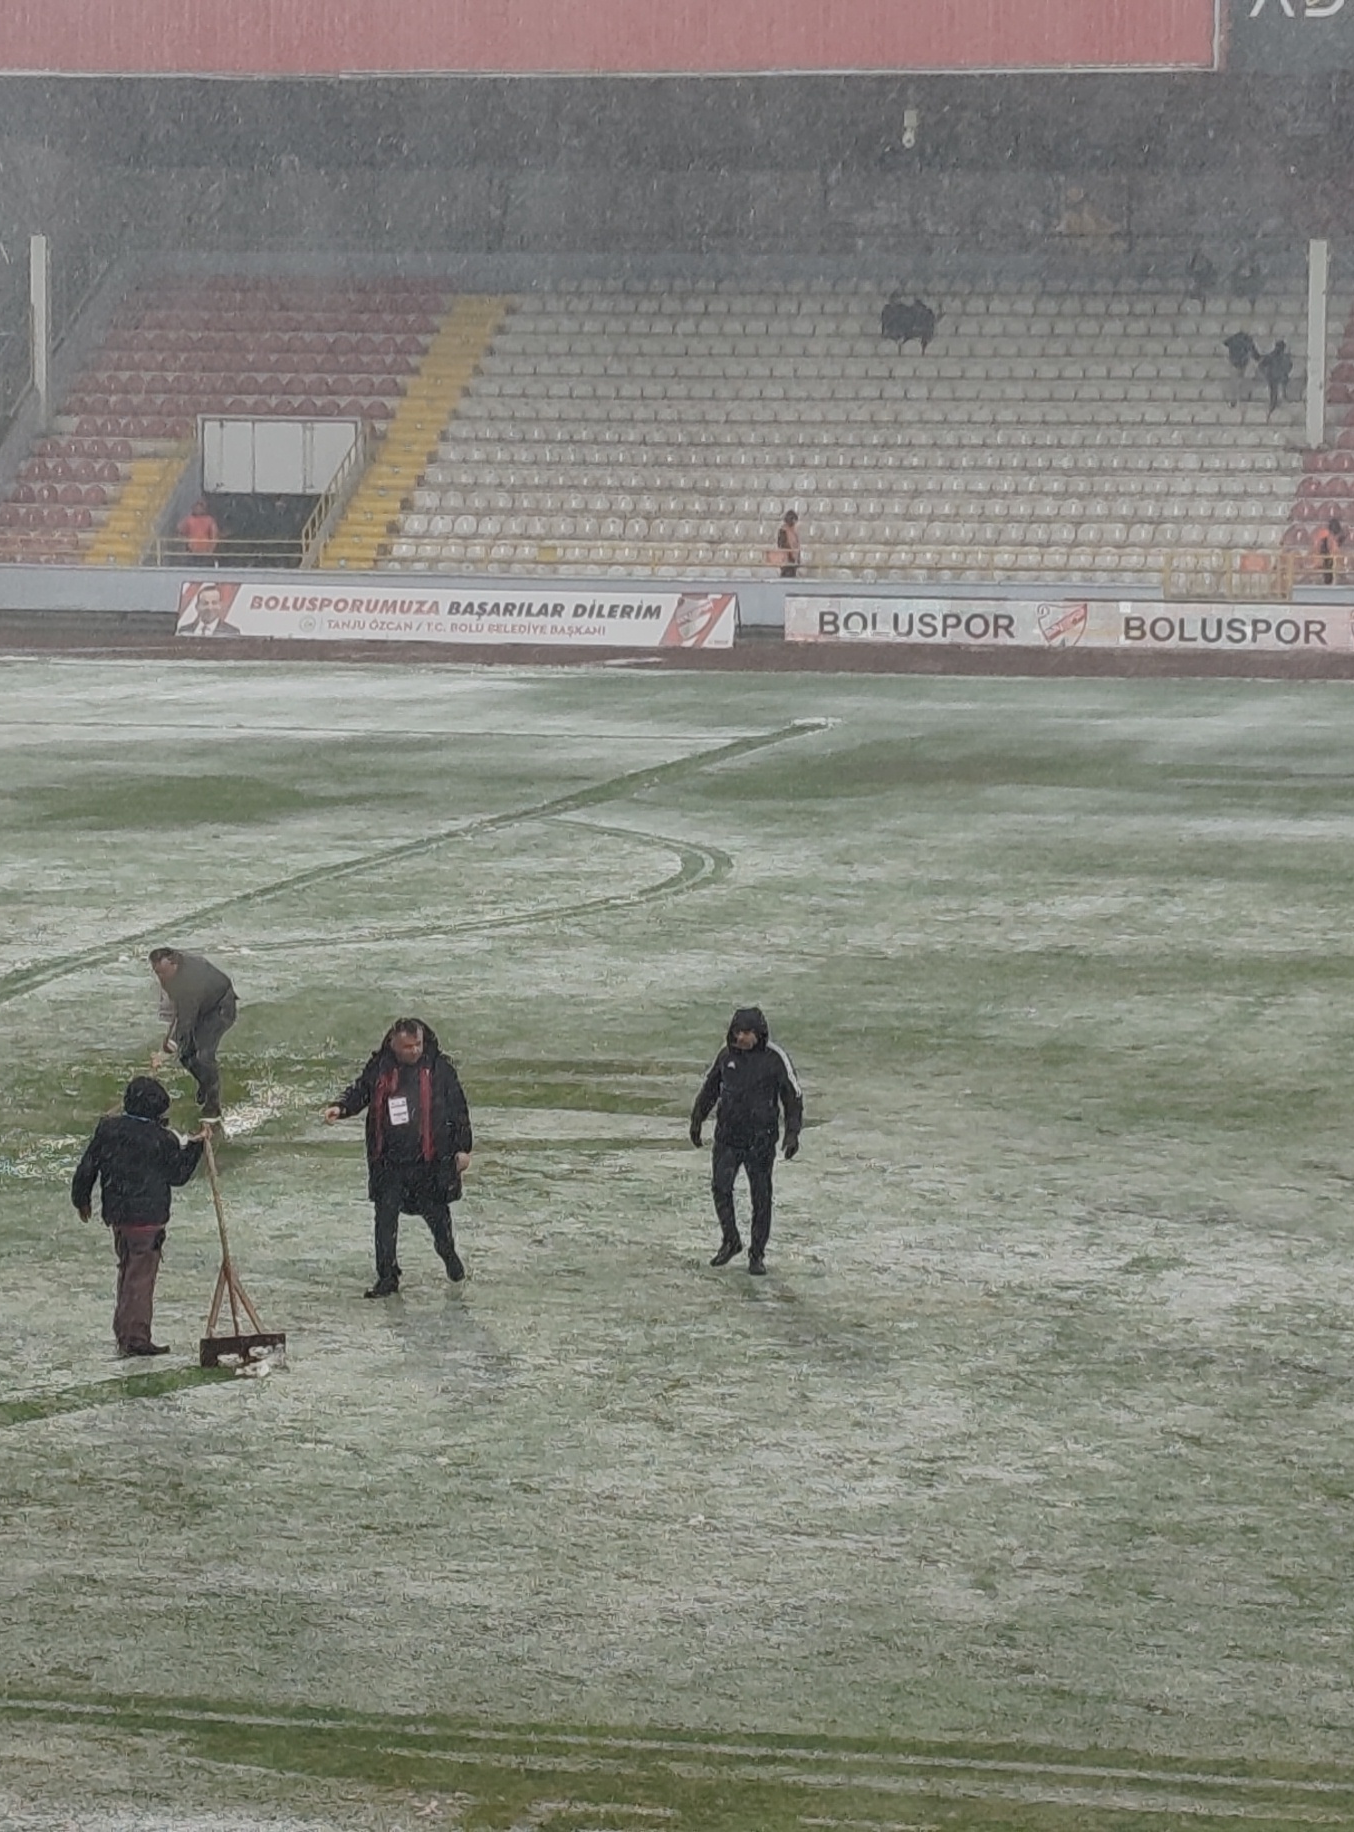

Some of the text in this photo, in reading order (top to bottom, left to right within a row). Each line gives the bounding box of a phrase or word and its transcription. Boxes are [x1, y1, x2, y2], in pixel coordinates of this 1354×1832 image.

[250, 595, 441, 616] BOLUSPORUMUZA
[447, 600, 566, 621] BAŞARILAR
[571, 598, 662, 620] DİLERİM
[327, 619, 366, 630] TANJU
[369, 617, 413, 631] ÖZCAN
[450, 622, 484, 633] BOLU
[818, 611, 1016, 639] BOLUSPOR
[1123, 616, 1328, 645] BOLUSPOR
